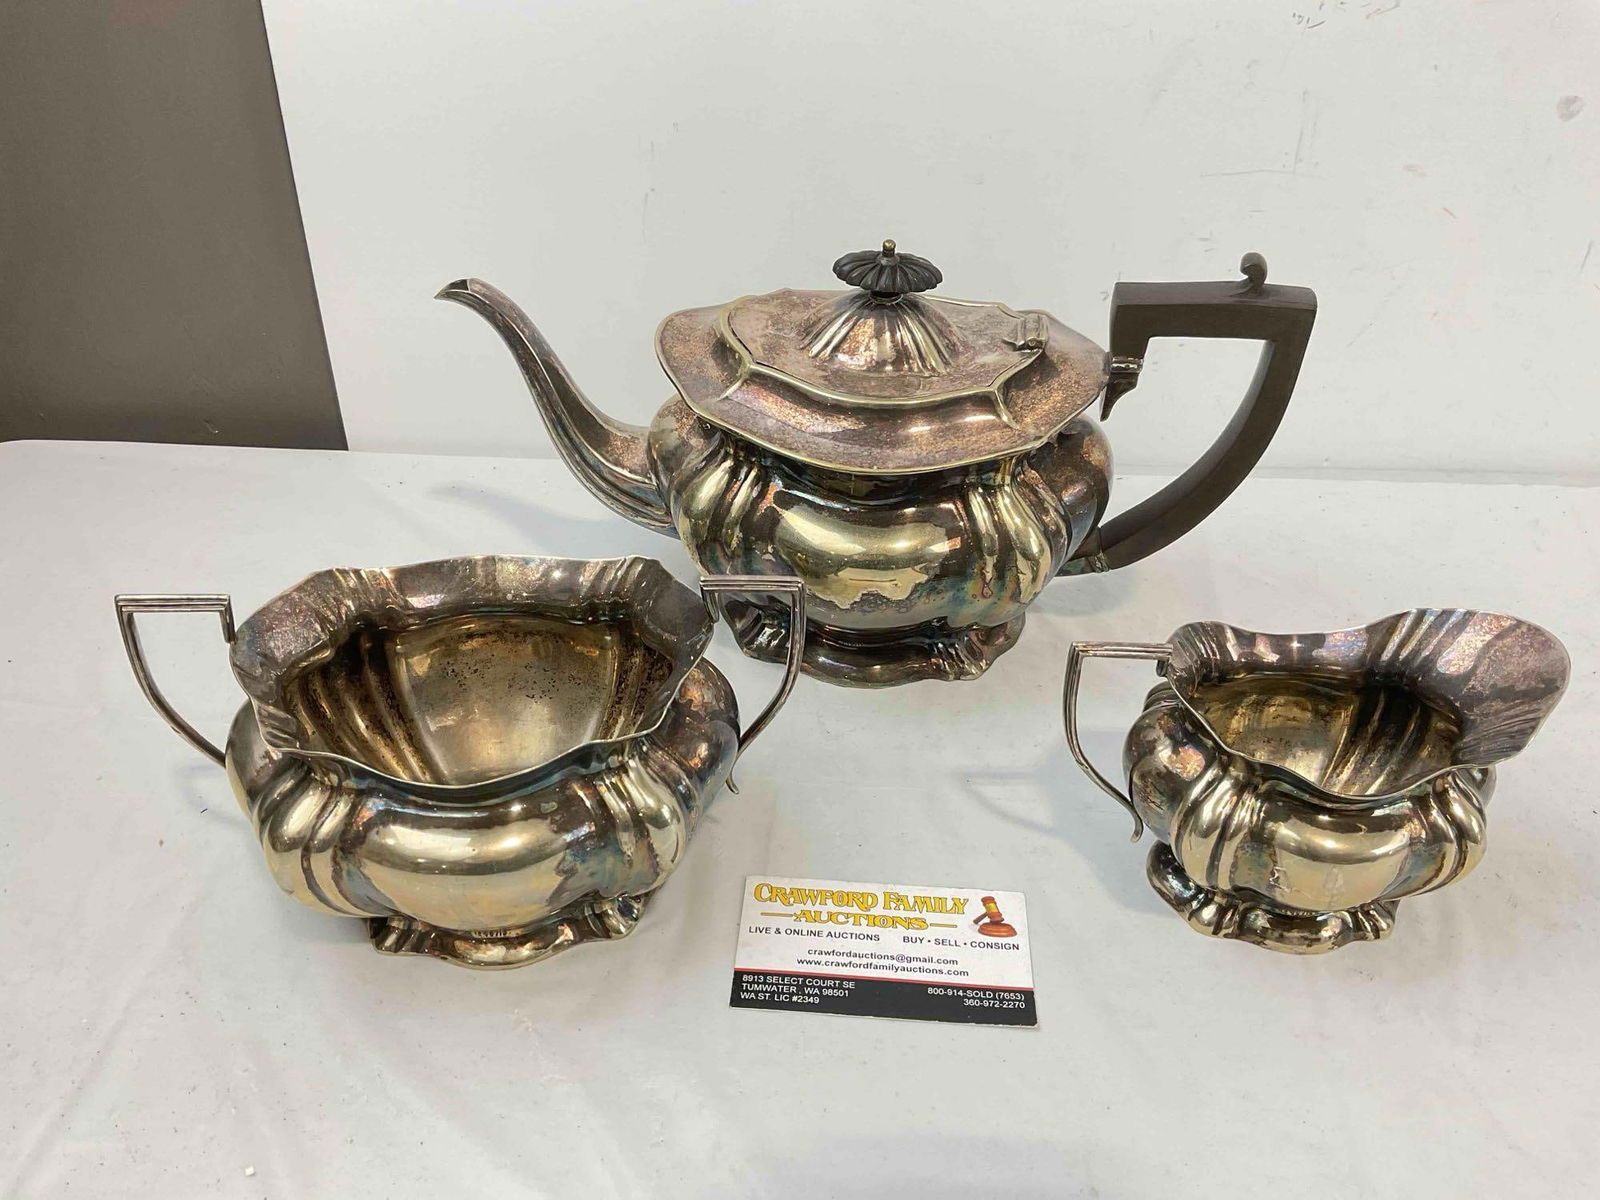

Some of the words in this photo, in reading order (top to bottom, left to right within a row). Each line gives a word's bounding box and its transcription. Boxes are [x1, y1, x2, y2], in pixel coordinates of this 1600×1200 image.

[754, 883, 878, 912] CRAWFORD
[882, 891, 969, 914] FAMILY
[794, 909, 929, 930] AUCTIONS
[748, 926, 772, 935] LIVE
[774, 927, 782, 935] &
[785, 928, 824, 938] ONLINE
[826, 931, 880, 941] AUCTIONS
[903, 936, 925, 944] BUY
[934, 938, 960, 947] SELL
[970, 941, 1020, 951] CONSIGN
[807, 948, 959, 966] crawfordauctions@gmail.com
[797, 958, 969, 977] www.crawfordfamilyauctions.com
[742, 974, 764, 983] 8913
[766, 976, 804, 985] SELECT
[806, 978, 840, 988] COURT
[842, 981, 855, 989] SE
[740, 991, 756, 1000] WA
[774, 994, 790, 1002] LIC
[792, 995, 820, 1004] #2349
[804, 987, 820, 995] WA
[822, 988, 849, 997] 98501
[927, 987, 993, 999] 800-914-SOLD
[995, 991, 1025, 1001] (7653)
[963, 998, 1026, 1009] 360-972-2270
